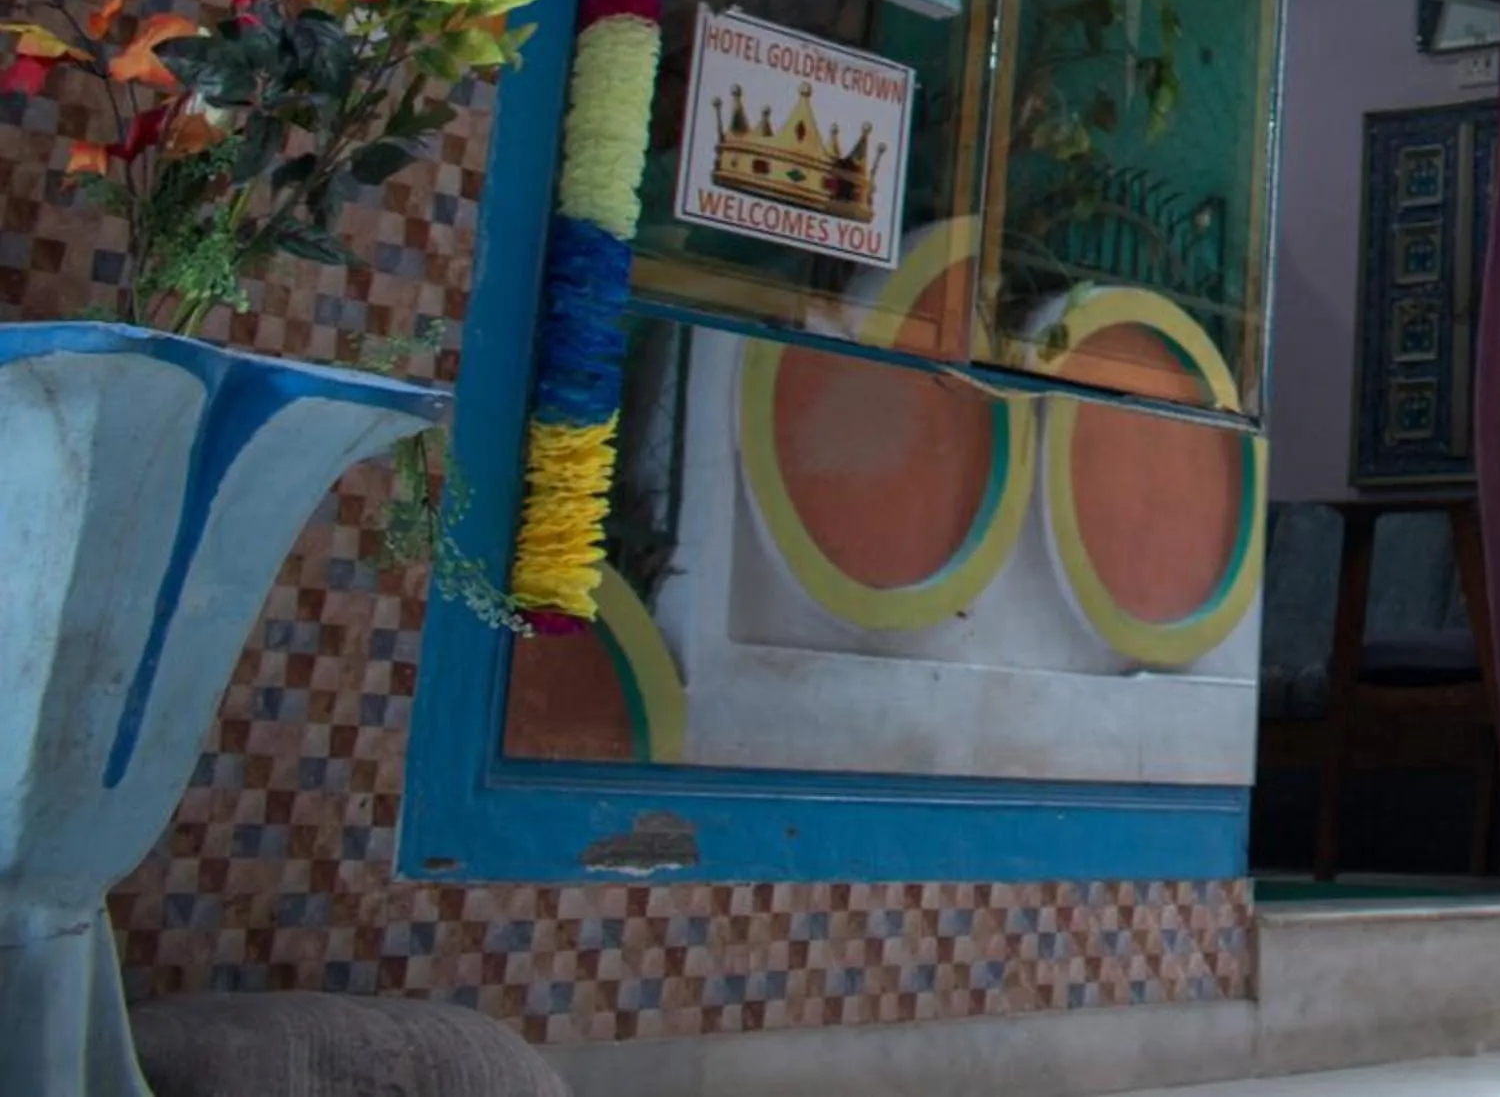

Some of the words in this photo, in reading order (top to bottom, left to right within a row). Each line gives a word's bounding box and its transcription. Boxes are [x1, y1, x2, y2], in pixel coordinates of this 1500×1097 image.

[705, 23, 763, 65] HOTEL
[768, 42, 836, 85] GOLDEN
[841, 66, 904, 103] CROWN
[697, 188, 830, 243] WELCOMES
[836, 224, 883, 255] YOU
